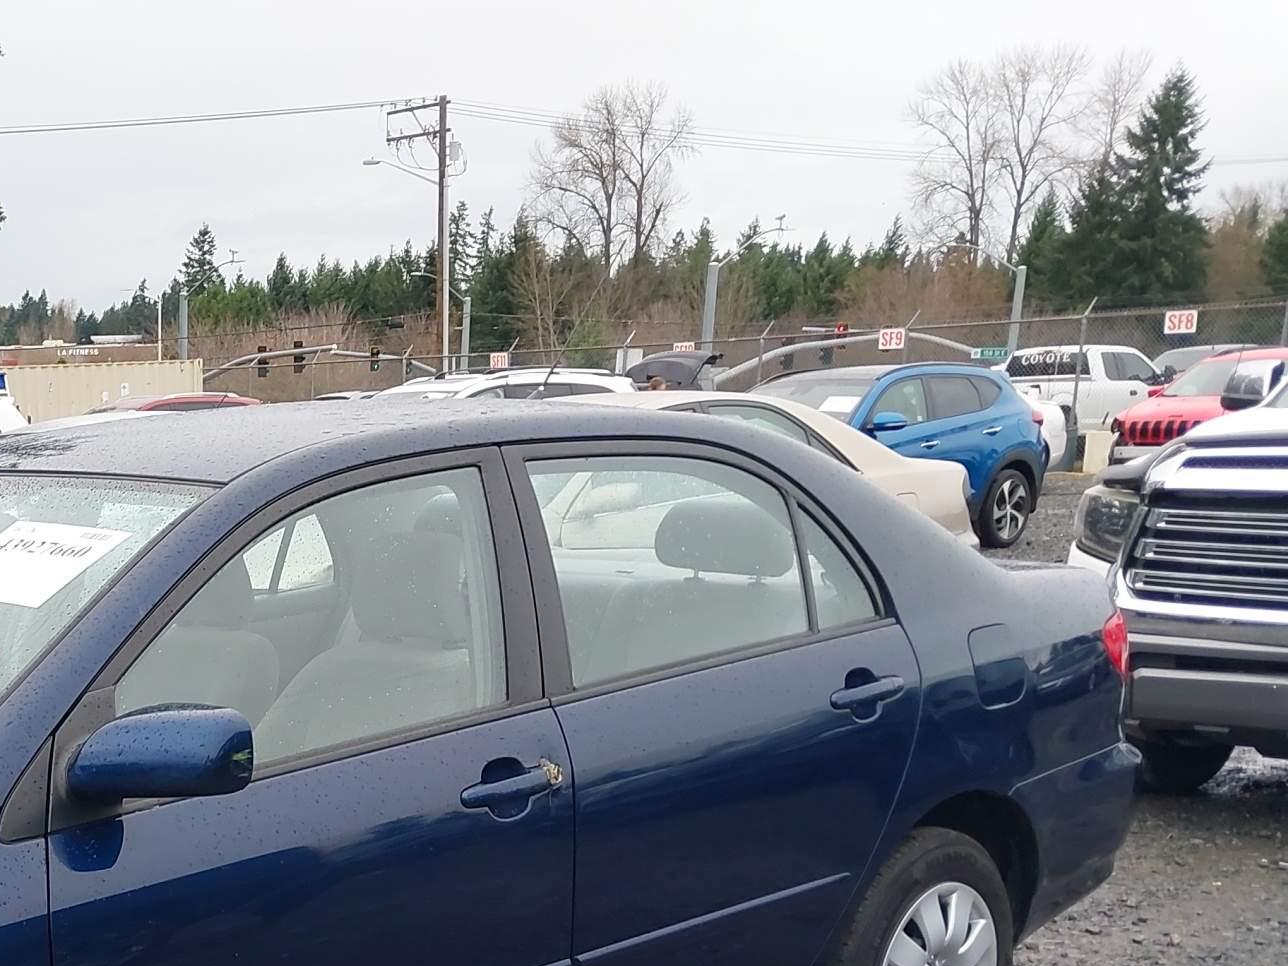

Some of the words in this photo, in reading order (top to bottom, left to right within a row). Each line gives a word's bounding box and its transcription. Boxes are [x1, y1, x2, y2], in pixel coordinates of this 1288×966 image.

[1168, 313, 1194, 330] SF8
[881, 331, 903, 347] SF9
[69, 348, 99, 356] FITNESS
[1021, 352, 1072, 366] COYOTE
